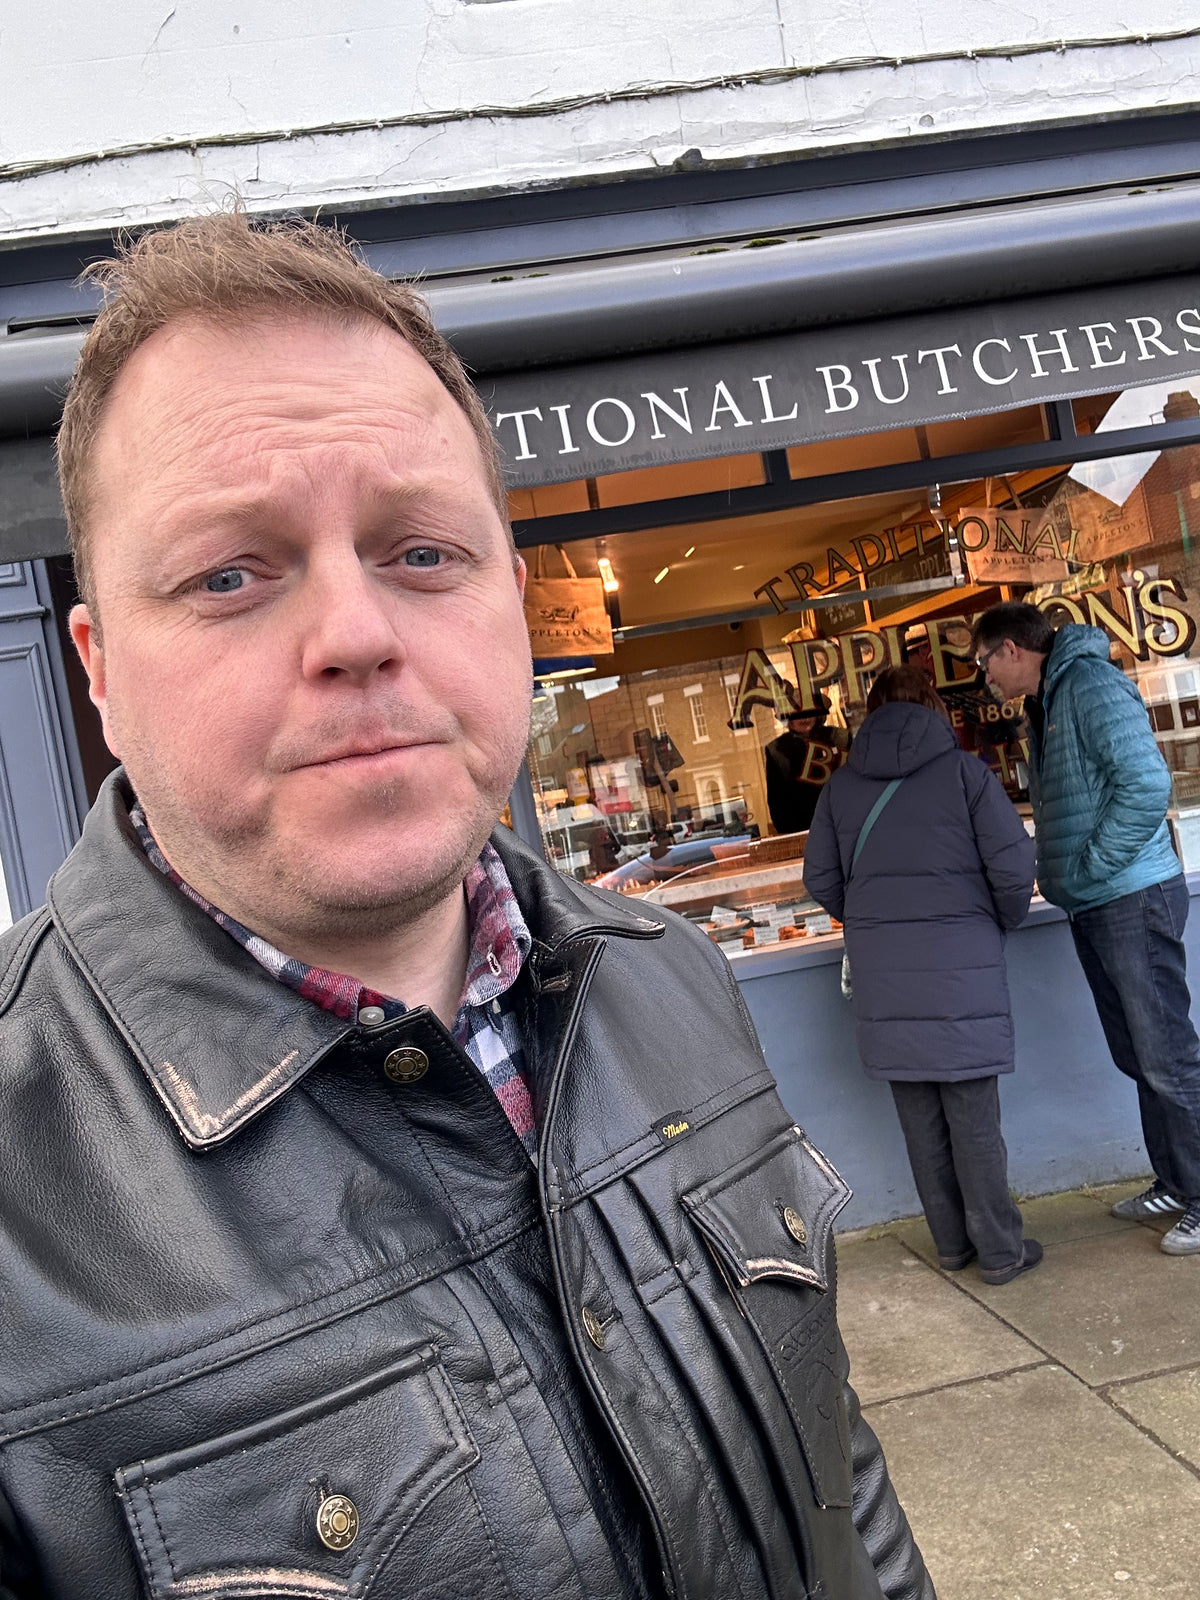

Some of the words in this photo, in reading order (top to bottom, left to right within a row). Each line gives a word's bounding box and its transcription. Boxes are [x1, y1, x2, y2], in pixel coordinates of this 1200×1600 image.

[815, 307, 1200, 414] BUTCHERS
[753, 515, 1092, 616] TRADITIONAL
[729, 569, 1196, 729] APPLEON'S
